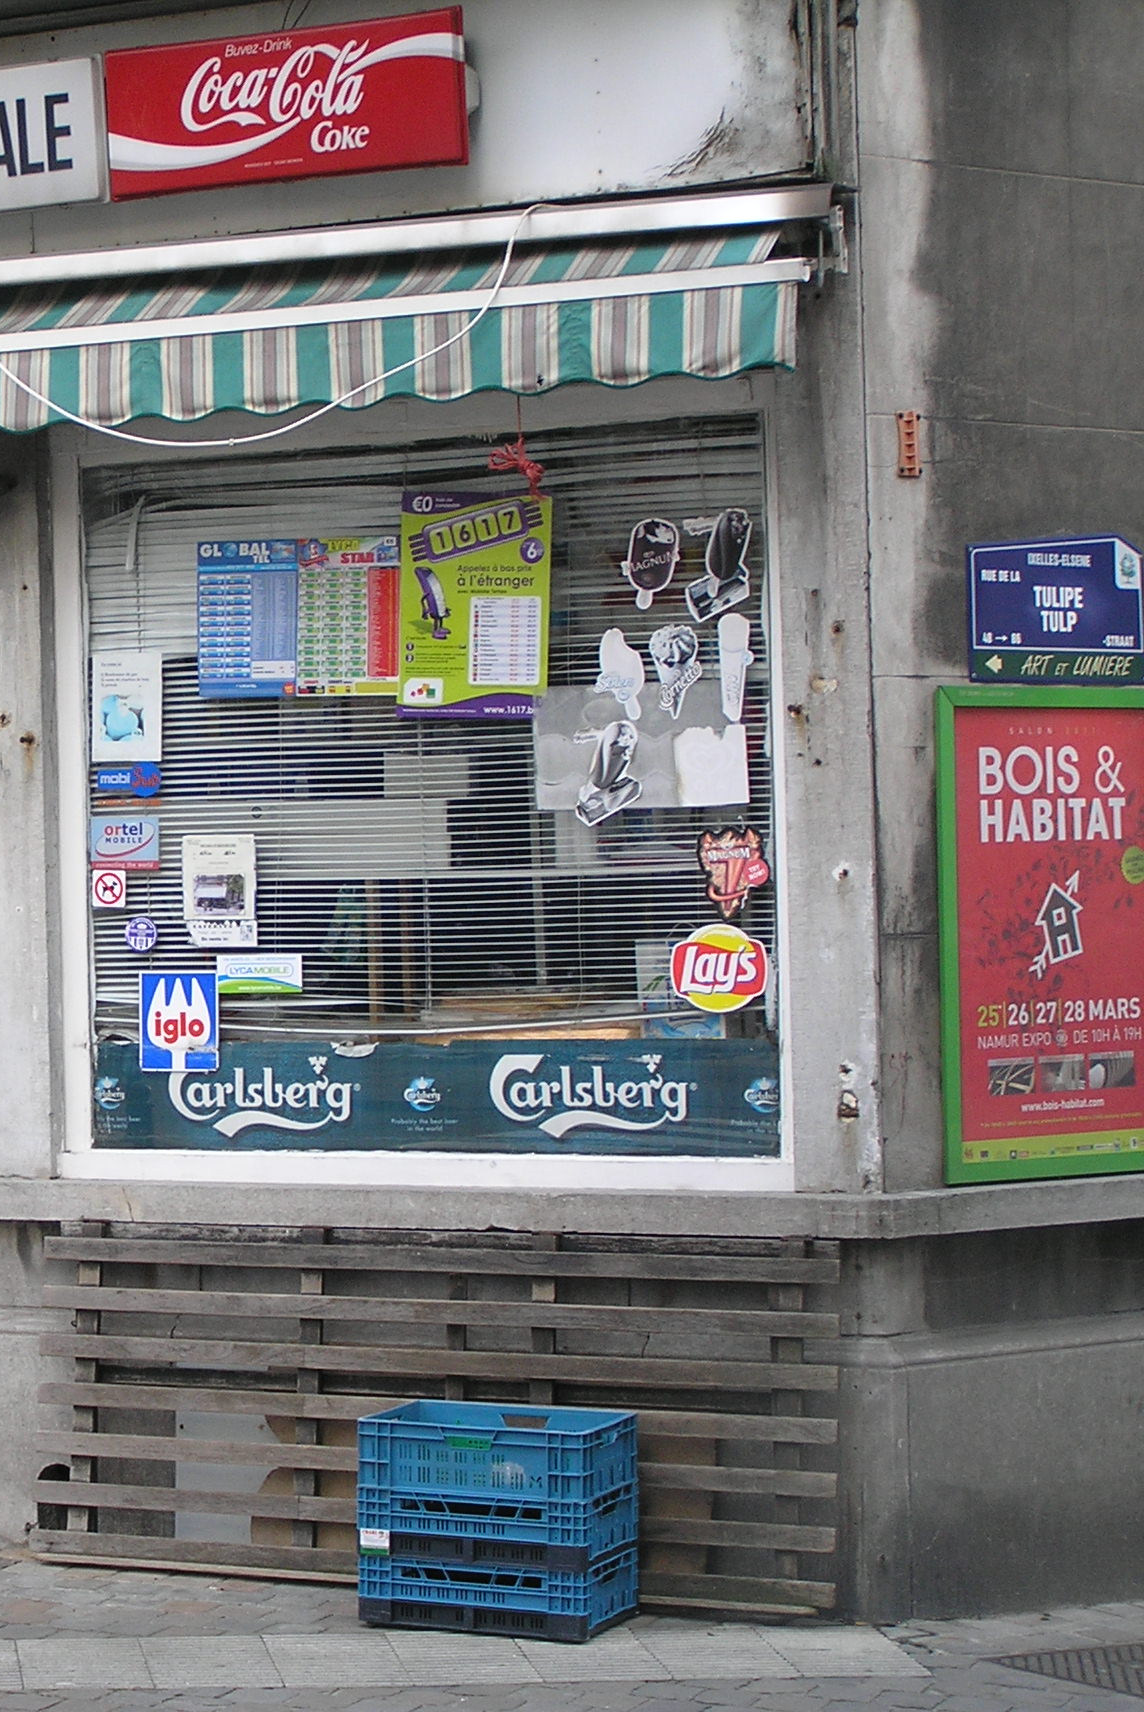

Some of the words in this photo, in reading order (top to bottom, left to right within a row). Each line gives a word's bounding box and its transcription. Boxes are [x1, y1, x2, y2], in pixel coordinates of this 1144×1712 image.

[224, 37, 292, 59] Buvez-Drink
[180, 39, 370, 133] Coca-Cola
[310, 124, 370, 154] Coke
[433, 510, 518, 550] 1617
[252, 555, 270, 564] TEL
[457, 574, 466, 587] à
[469, 574, 536, 589] l'étranger
[981, 569, 997, 581] RUE
[998, 570, 1010, 582] DE
[1010, 570, 1021, 582] LA
[1032, 585, 1084, 608] TULIPE
[1040, 610, 1078, 632] TULP
[1020, 655, 1055, 676] ART
[1054, 663, 1070, 676] ET
[1072, 655, 1135, 676] LUMIERE
[660, 660, 702, 709] Cornetto
[483, 705, 534, 715] www.1617.b
[1009, 727, 1054, 736] SALON
[978, 745, 1081, 795] BOIS
[1094, 745, 1126, 793] &
[104, 822, 143, 836] ortel
[979, 797, 1126, 843] HABITAT
[105, 836, 143, 844] MOBILE
[707, 847, 750, 861] MAGNUM
[229, 965, 290, 976] LYCAMOBILE
[680, 946, 758, 994] Lay's
[1008, 1003, 1030, 1026] 26
[1036, 1001, 1057, 1025] 27
[1064, 999, 1085, 1023] 28
[1088, 997, 1142, 1022] MARS
[155, 1011, 205, 1045] iglo
[977, 1033, 1020, 1050] NAMUR
[1022, 1031, 1052, 1048] EXPO
[1073, 1029, 1089, 1044] DE
[1091, 1027, 1110, 1043] 10H
[1123, 1026, 1142, 1041] 19H
[168, 1058, 353, 1138] Carlsberg
[489, 1054, 690, 1139] Carlsberg
